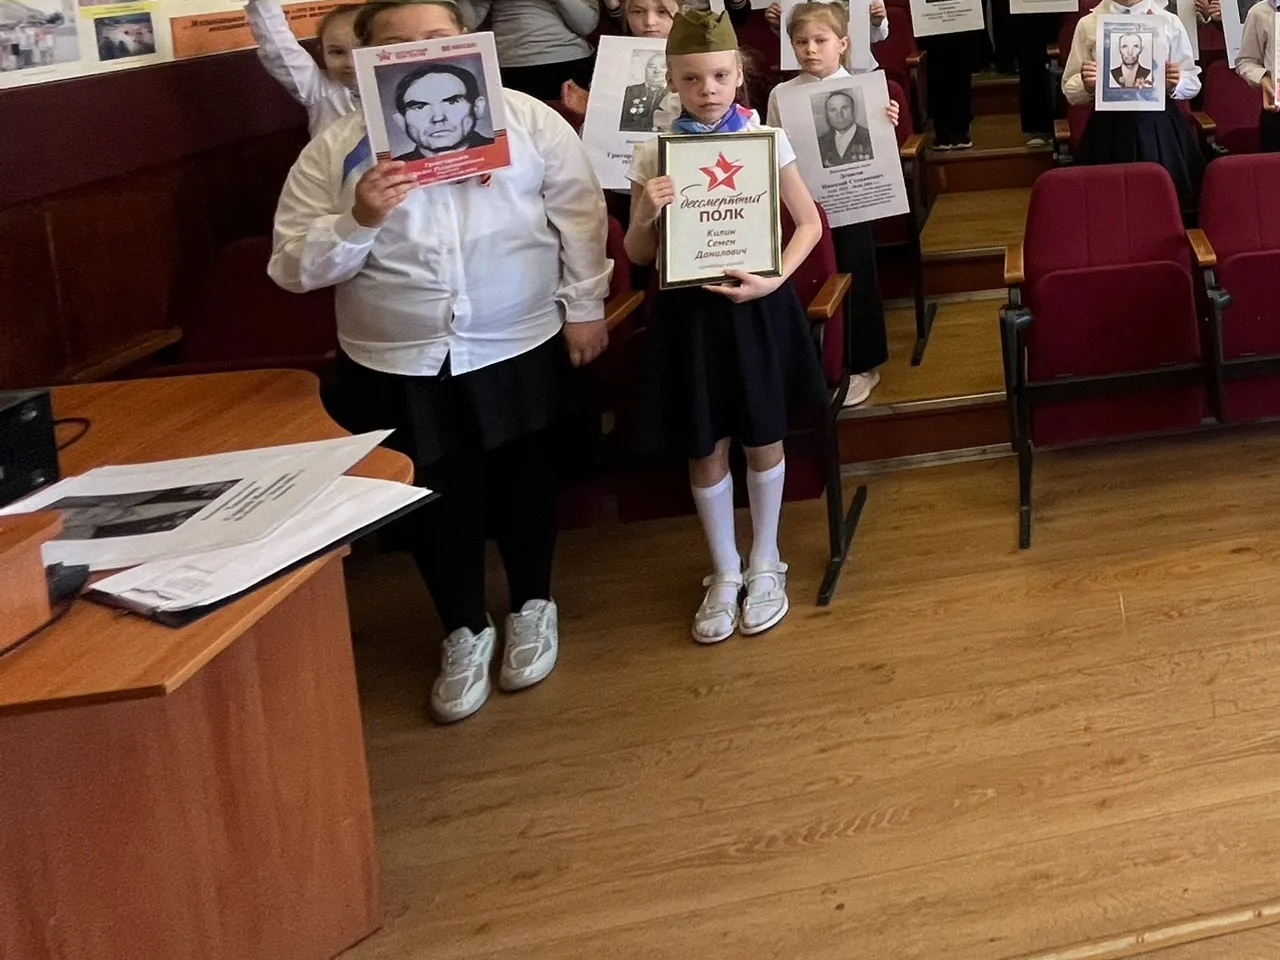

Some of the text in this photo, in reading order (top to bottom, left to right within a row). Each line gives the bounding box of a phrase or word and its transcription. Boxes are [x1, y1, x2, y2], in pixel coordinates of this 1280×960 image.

[700, 208, 744, 222] ПОЛК
[706, 228, 737, 238] Килин
[707, 238, 736, 248] Семен
[694, 248, 748, 260] Данилович
